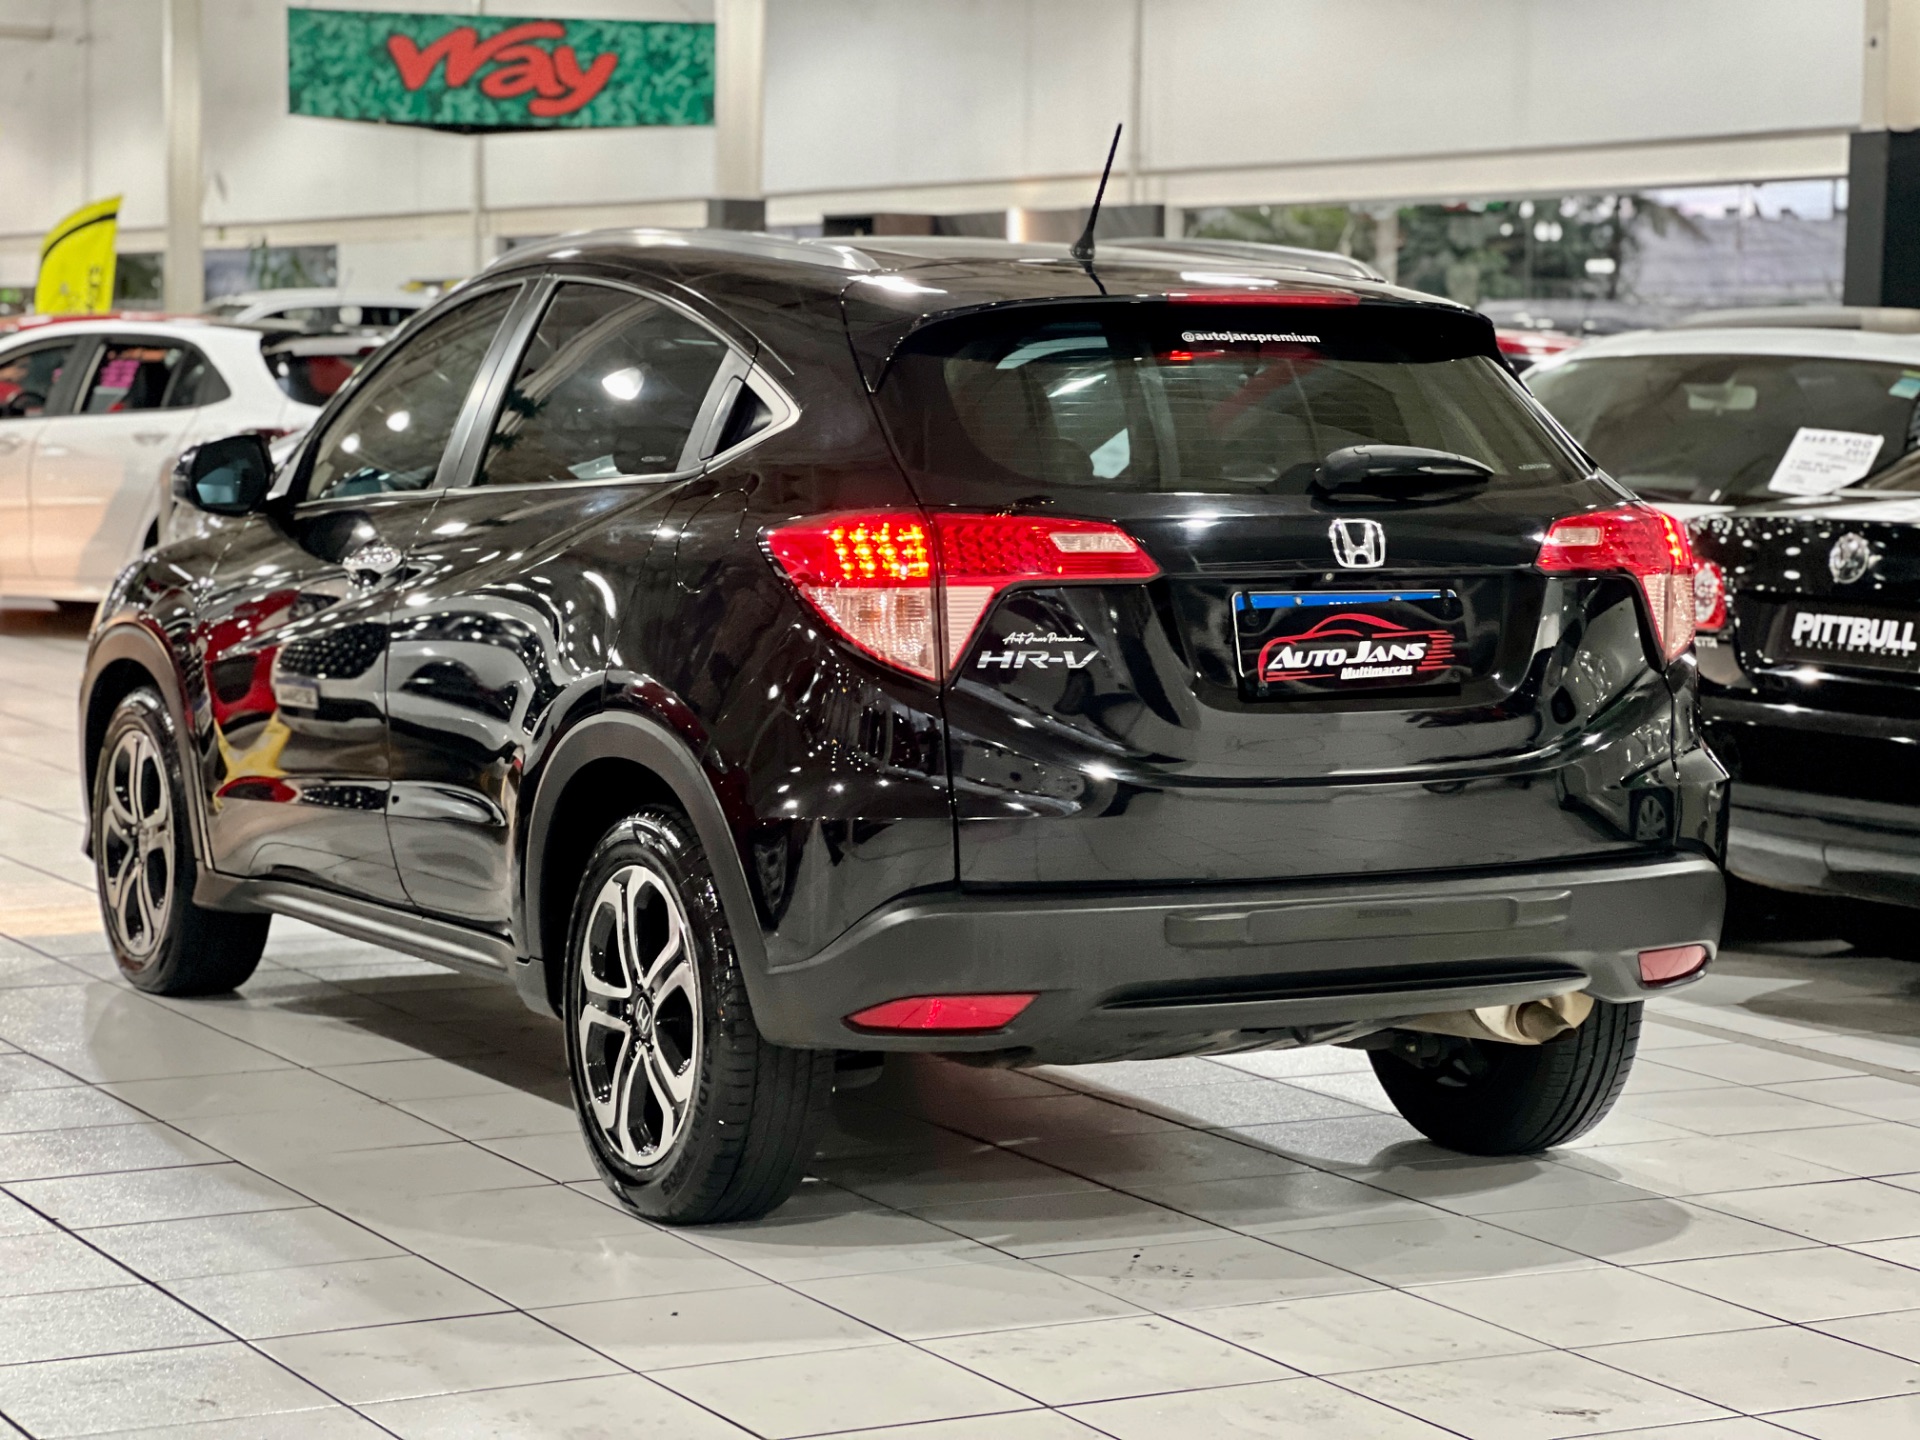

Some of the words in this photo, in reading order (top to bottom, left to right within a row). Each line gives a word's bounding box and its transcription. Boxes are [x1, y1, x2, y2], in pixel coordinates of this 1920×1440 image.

[387, 21, 619, 117] Way
[1181, 331, 1321, 343] @autojanspremium
[1791, 612, 1917, 651] PITTBULL
[976, 650, 1099, 669] HR-V
[1267, 646, 1347, 669] AUTO
[1345, 640, 1427, 665] JANS
[1340, 665, 1413, 680] Multimarcas
